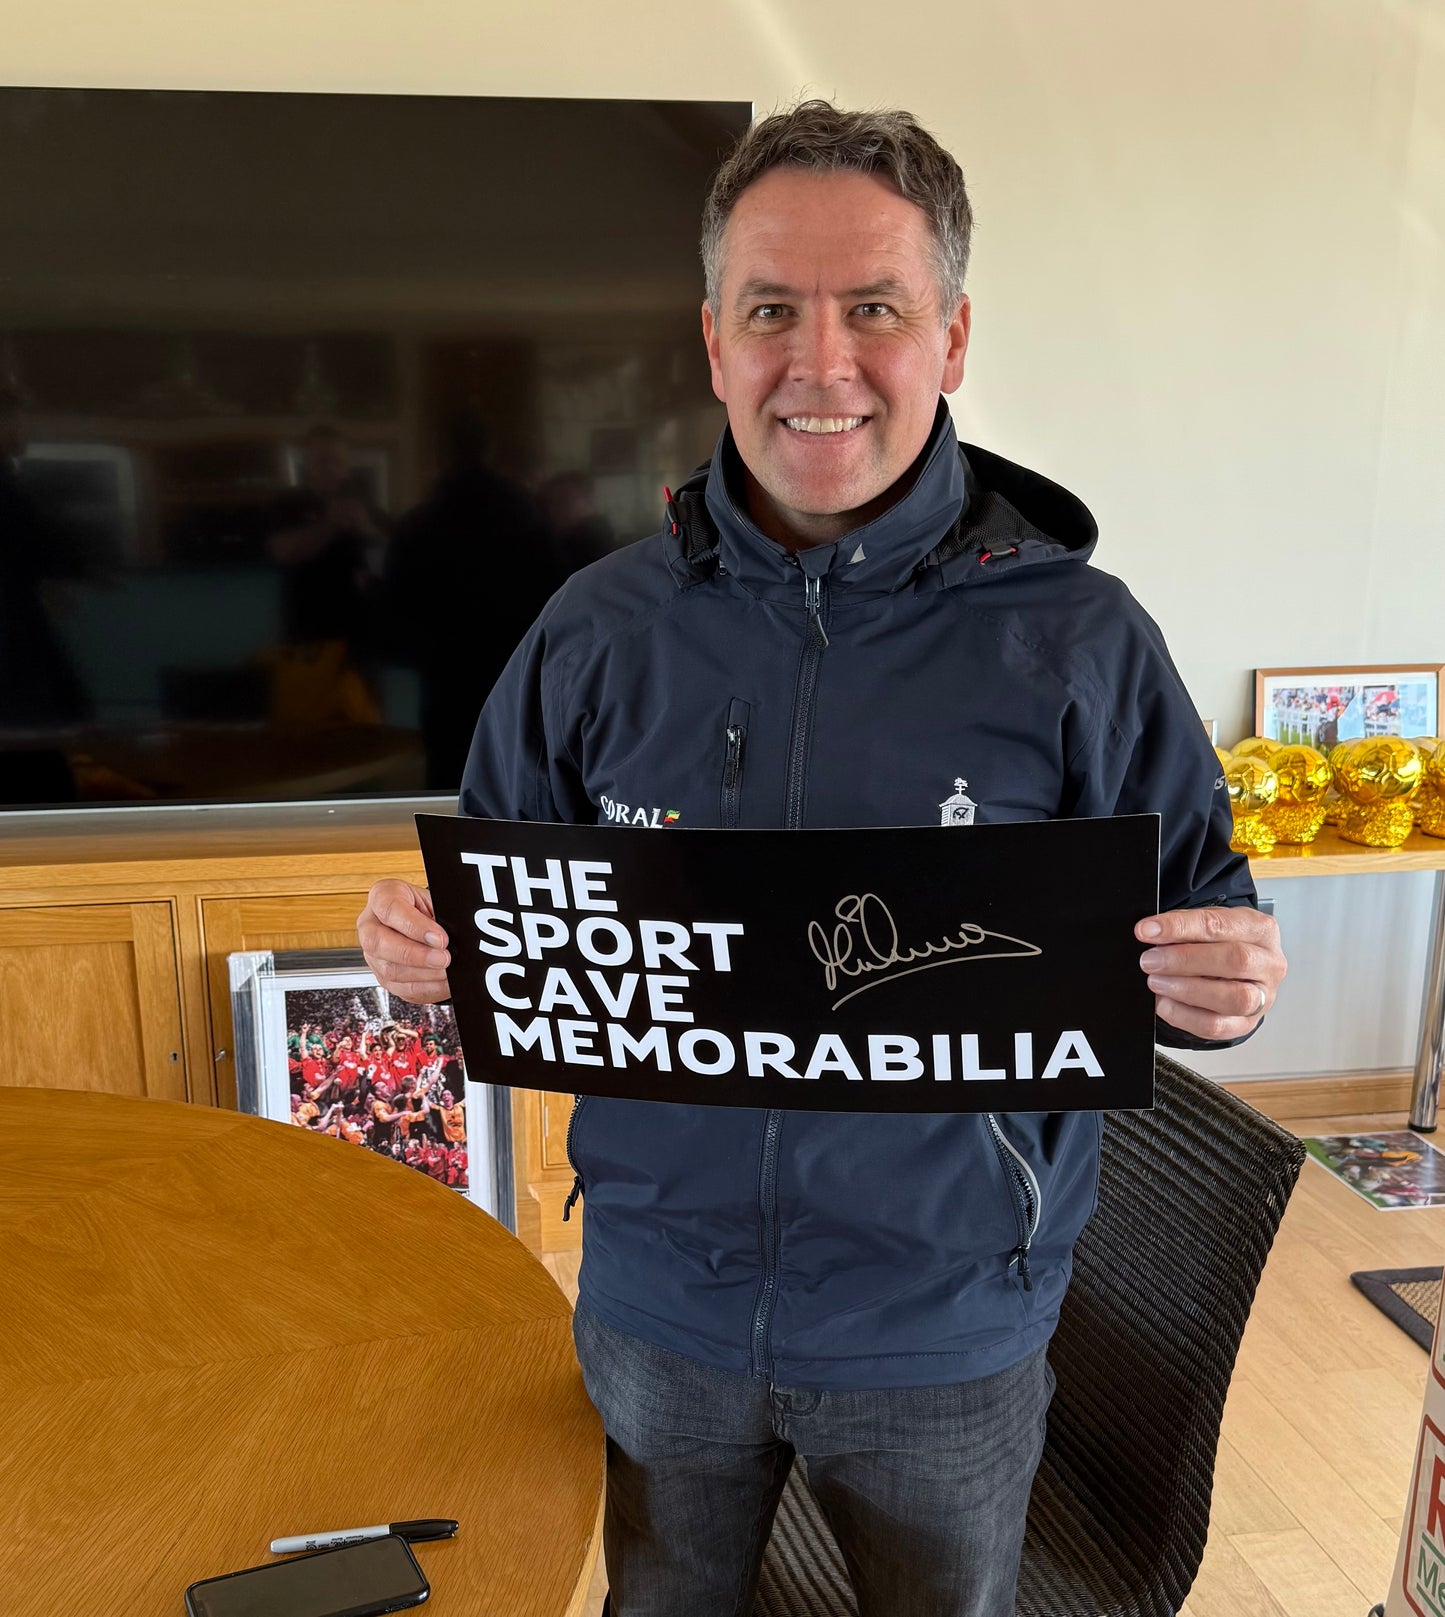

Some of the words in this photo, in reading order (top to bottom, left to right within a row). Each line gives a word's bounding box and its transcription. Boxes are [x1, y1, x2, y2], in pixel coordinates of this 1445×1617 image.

[461, 853, 618, 911] THE
[475, 909, 744, 971] SPORT
[486, 963, 694, 1022] CAVE
[494, 1012, 1104, 1080] MEMORABILIA
